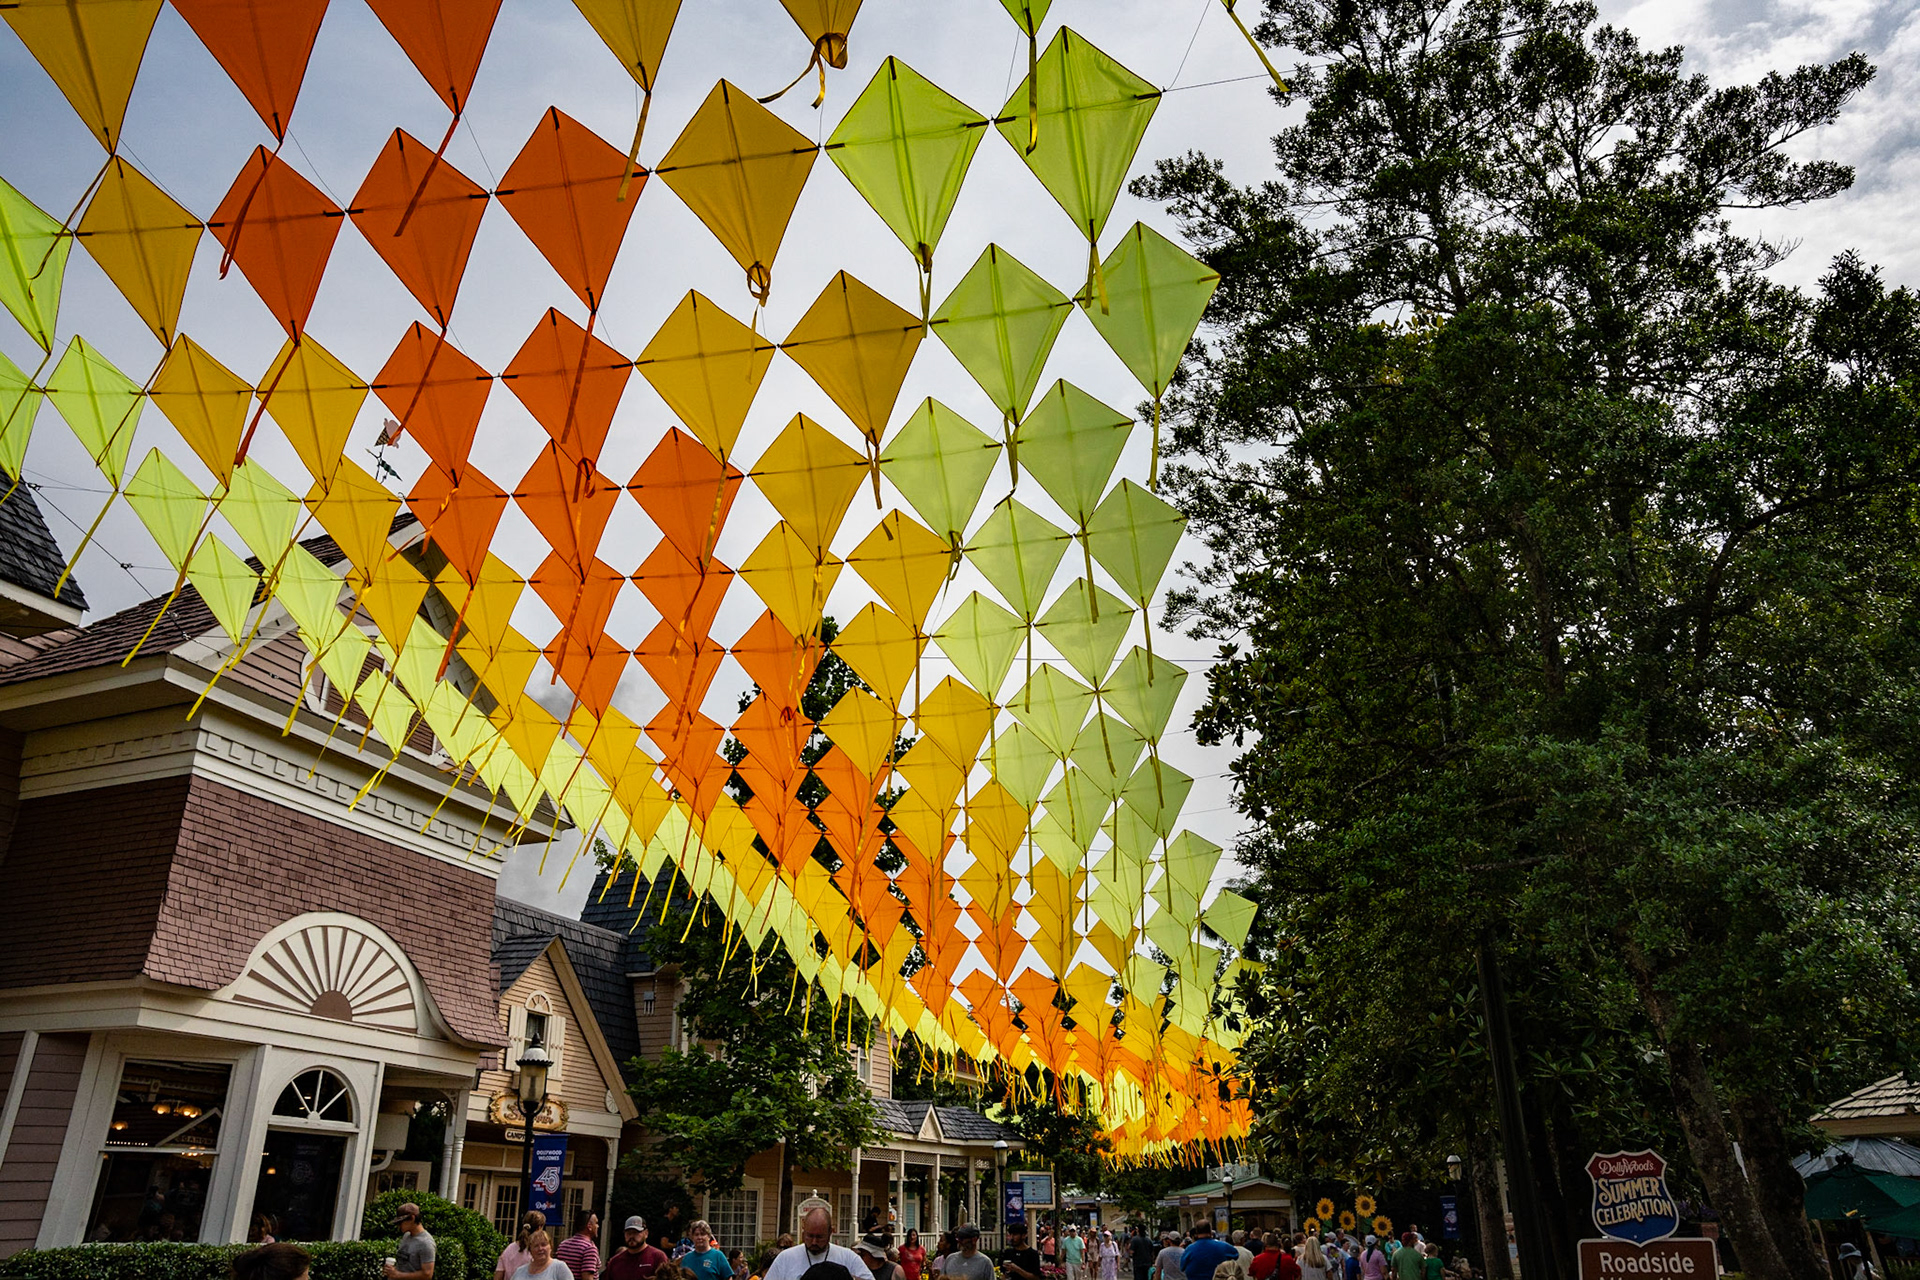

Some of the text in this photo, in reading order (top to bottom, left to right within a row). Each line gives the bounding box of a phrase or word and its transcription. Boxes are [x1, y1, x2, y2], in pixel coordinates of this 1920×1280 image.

[1597, 1177, 1662, 1206] SUMMER
[1596, 1198, 1673, 1226] CELEBRATION
[1599, 1251, 1695, 1273] Roadside
